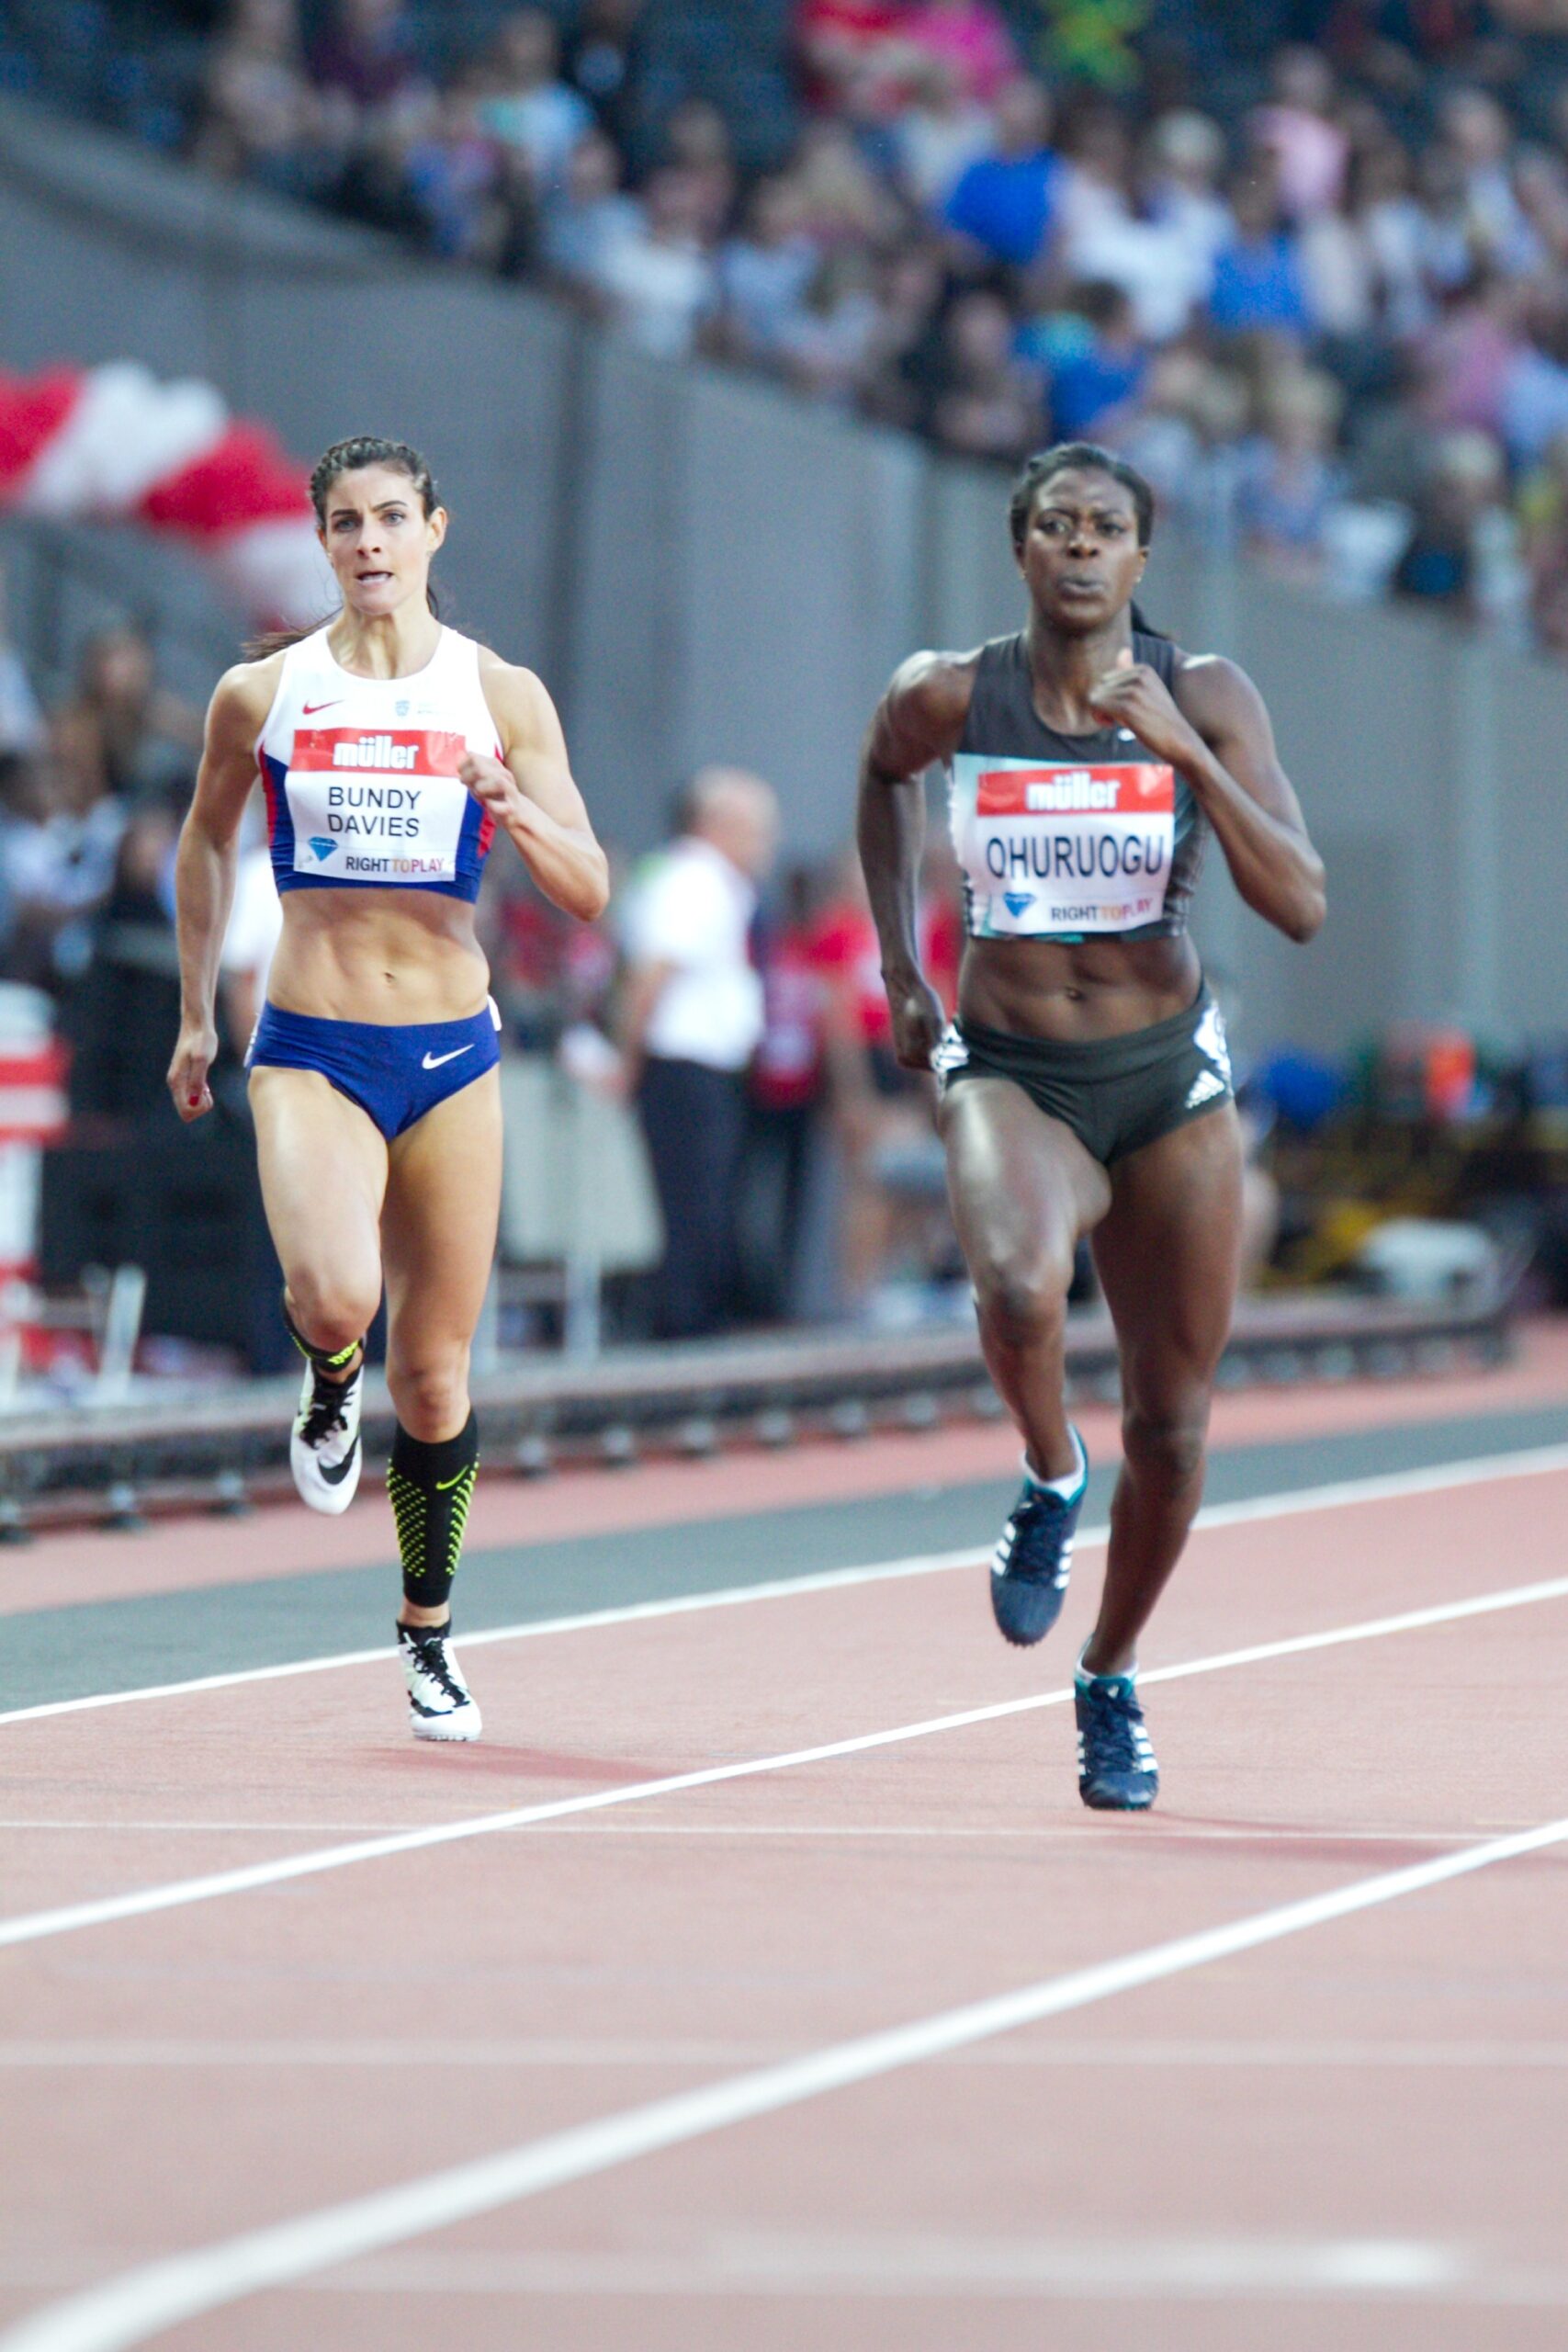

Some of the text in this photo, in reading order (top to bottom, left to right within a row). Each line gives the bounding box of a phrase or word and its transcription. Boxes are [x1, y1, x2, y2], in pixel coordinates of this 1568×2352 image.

[333, 735, 419, 769] müller
[328, 786, 421, 810] BUNDY
[1028, 772, 1120, 808] müller
[328, 815, 419, 837] DAVIES
[987, 835, 1163, 877] OHURUOGU
